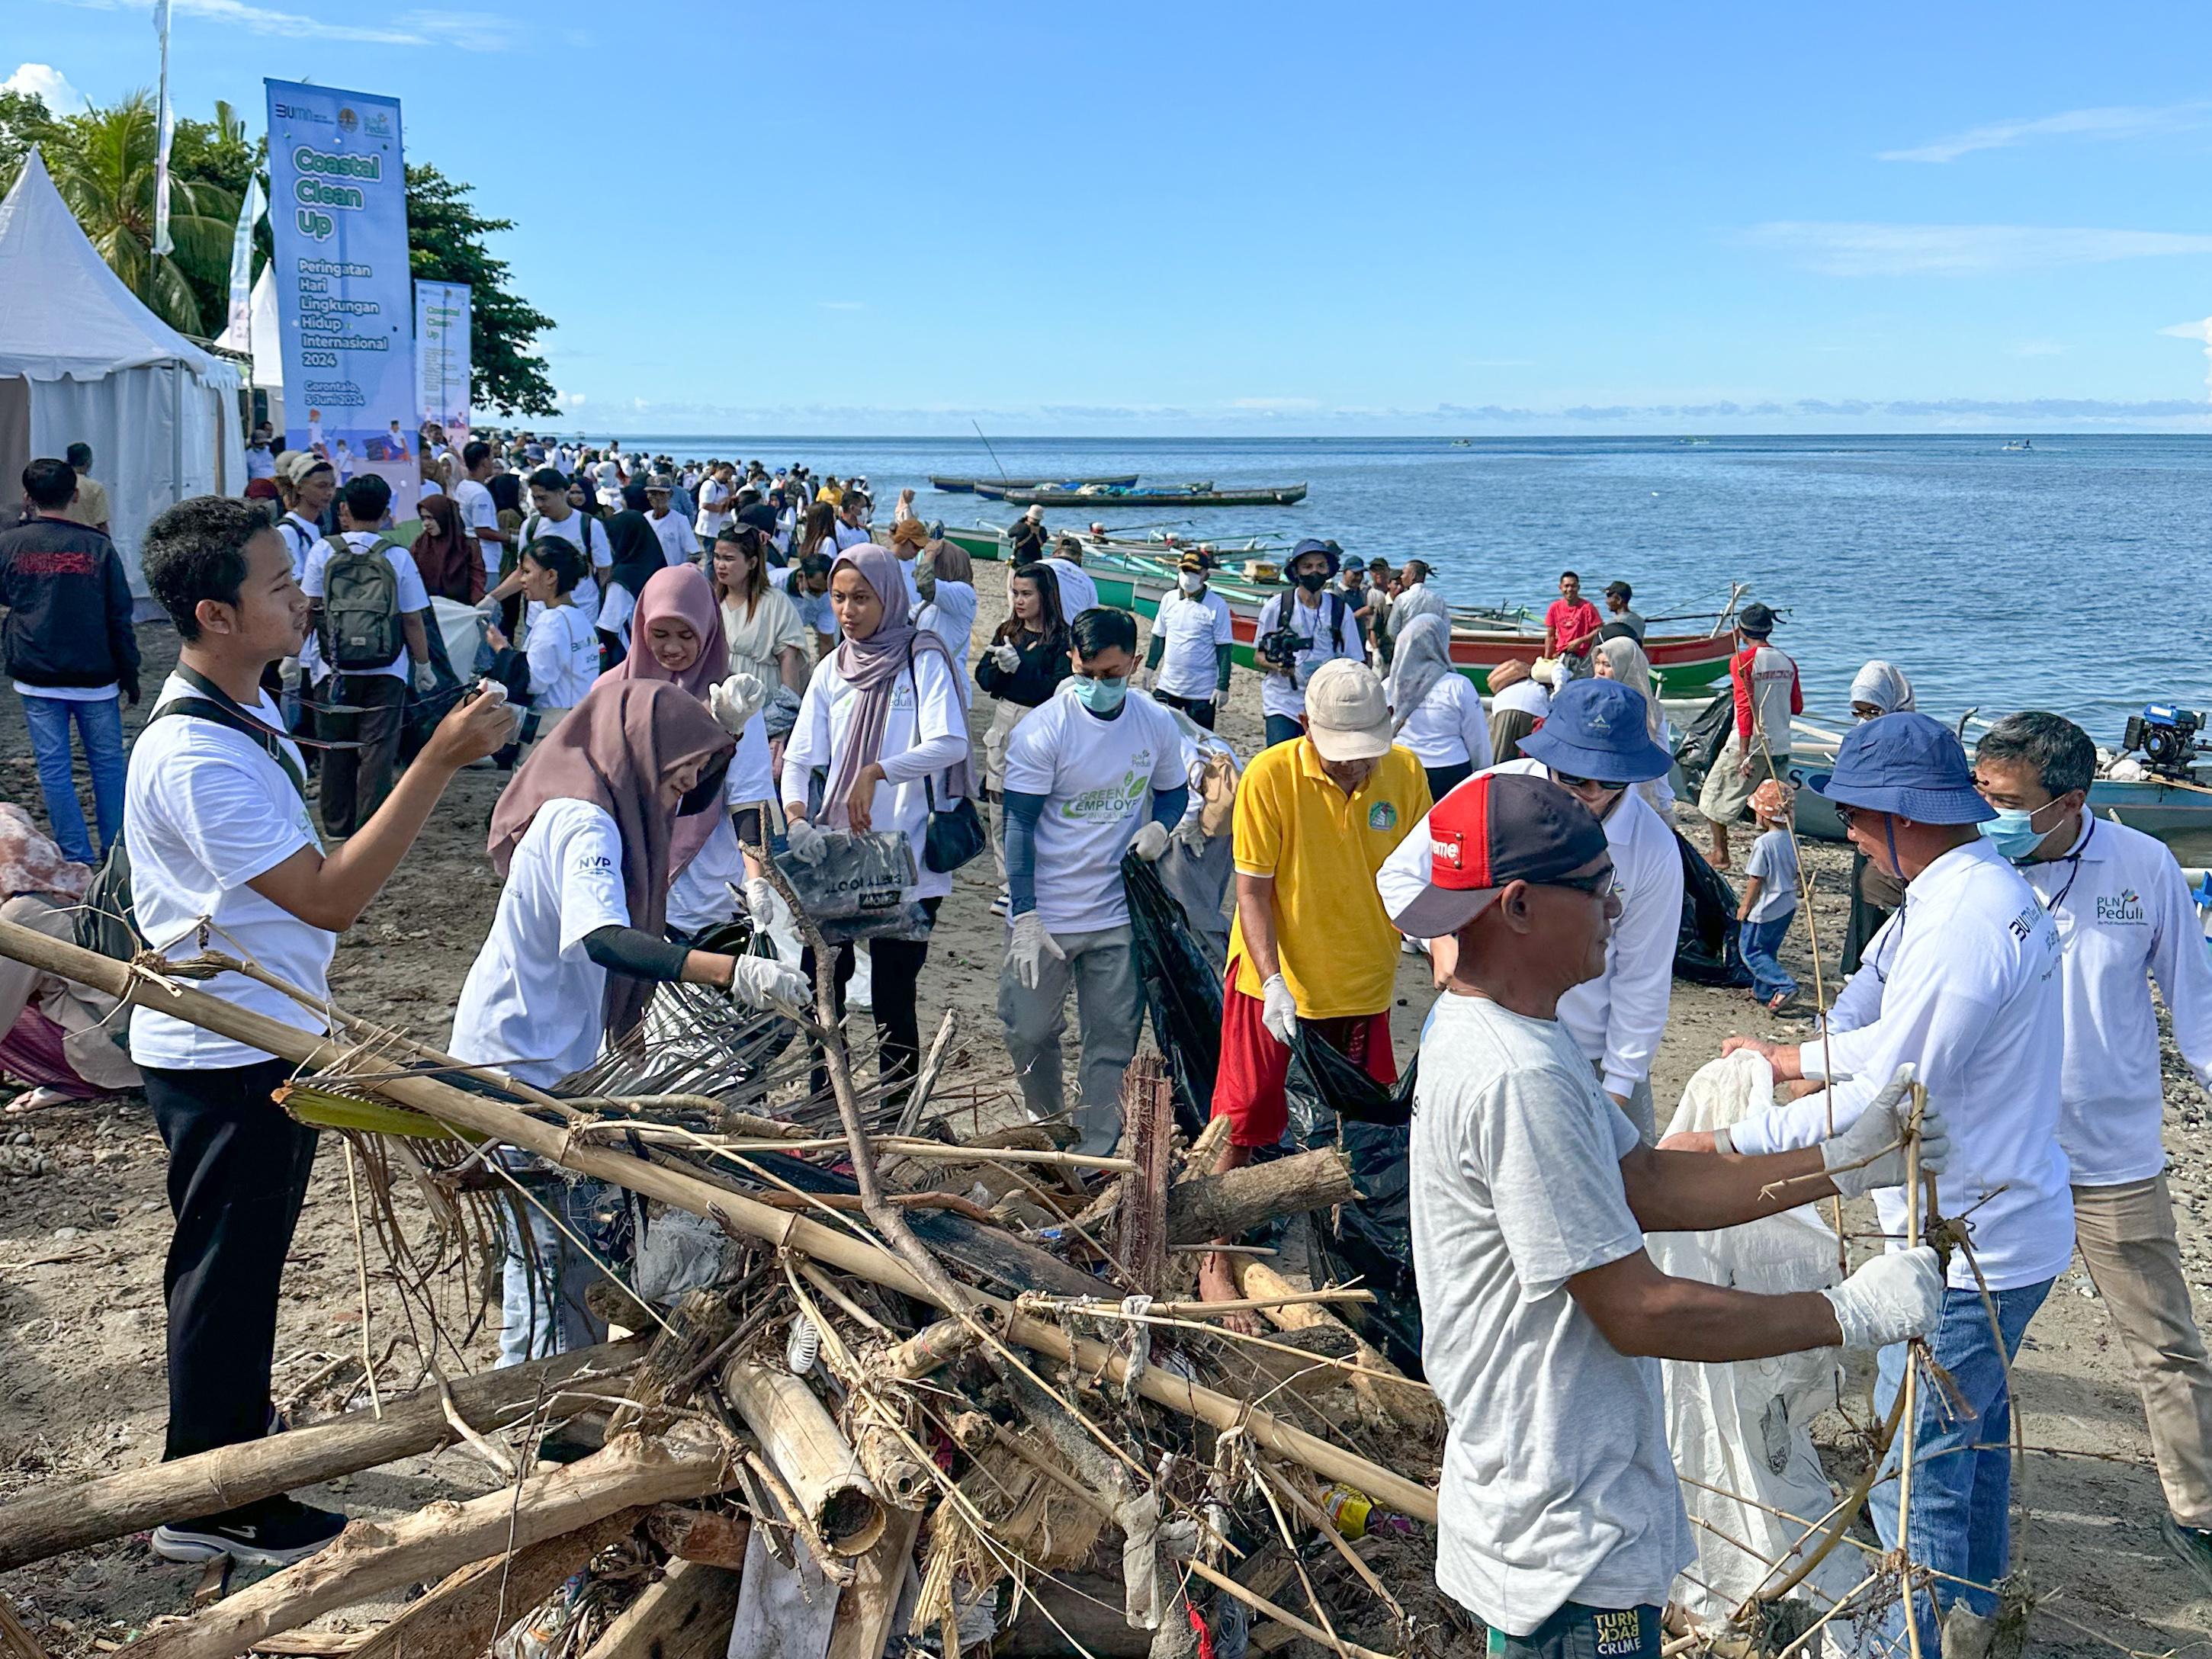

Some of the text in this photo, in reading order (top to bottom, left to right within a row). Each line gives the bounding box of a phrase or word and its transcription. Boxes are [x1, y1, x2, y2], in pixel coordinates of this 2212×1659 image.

[294, 146, 380, 181] Coastal
[295, 178, 364, 209] Clean
[297, 209, 333, 240] Up
[299, 259, 371, 277] Peringatan
[300, 278, 327, 292] Hari
[301, 296, 380, 316] Lingkungan
[302, 316, 342, 333] Hidup
[303, 335, 388, 351] Internasional
[303, 353, 336, 367] 2024
[306, 395, 313, 406] 5
[338, 395, 365, 406] 2024
[1079, 788, 1125, 803] GREEN
[579, 856, 611, 869] NVP
[2097, 896, 2121, 907] PLN
[2097, 905, 2143, 920] Peduli
[1594, 1609, 1639, 1629] TURN
[1597, 1637, 1642, 1655] CRIME
